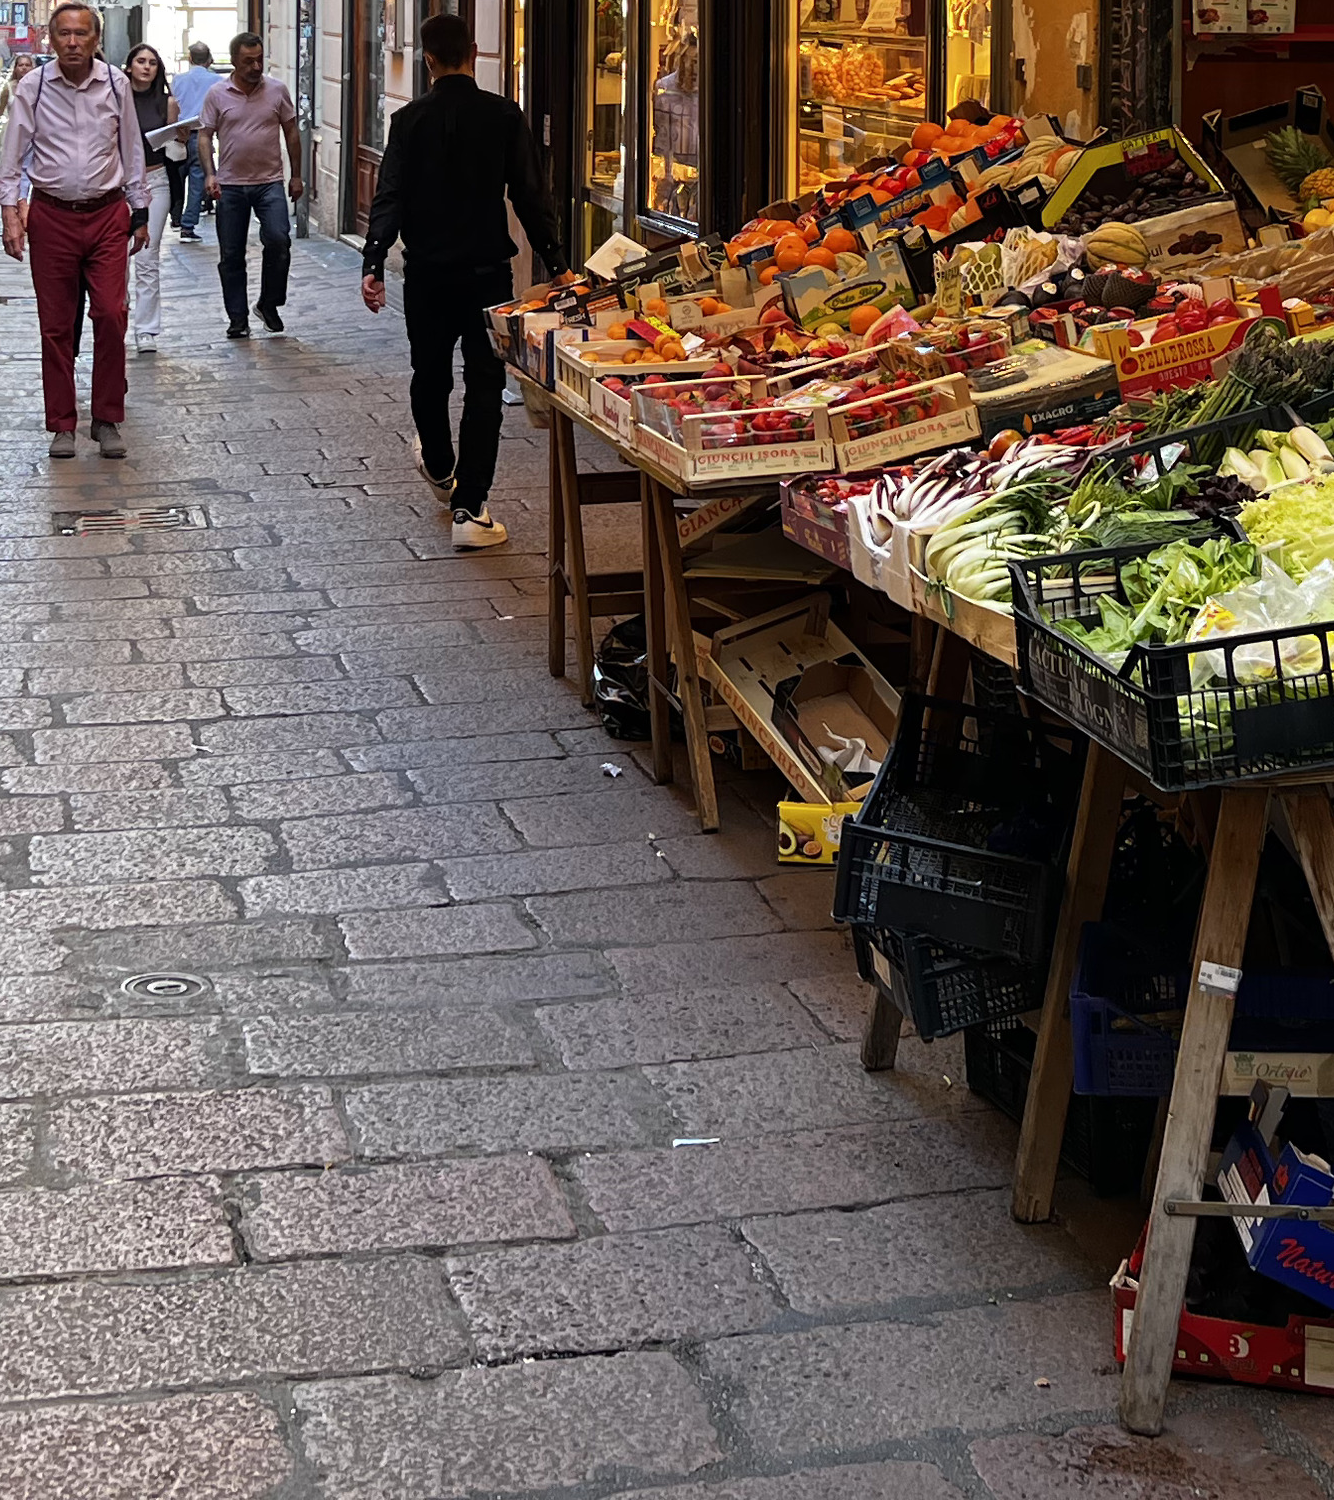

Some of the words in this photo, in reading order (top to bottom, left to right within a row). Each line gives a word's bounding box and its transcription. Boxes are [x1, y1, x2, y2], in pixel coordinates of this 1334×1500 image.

[1121, 131, 1162, 150] DATTERI
[1138, 336, 1216, 372] PELLEROSSA
[1159, 364, 1188, 382] QUESTO
[1032, 404, 1074, 424] EXAGRO
[848, 432, 902, 456] GIUNCHI
[906, 422, 946, 438] ISORA
[697, 451, 754, 465] GIUNCHI
[757, 448, 798, 461] ISORA
[723, 681, 806, 789] GIANCARLO
